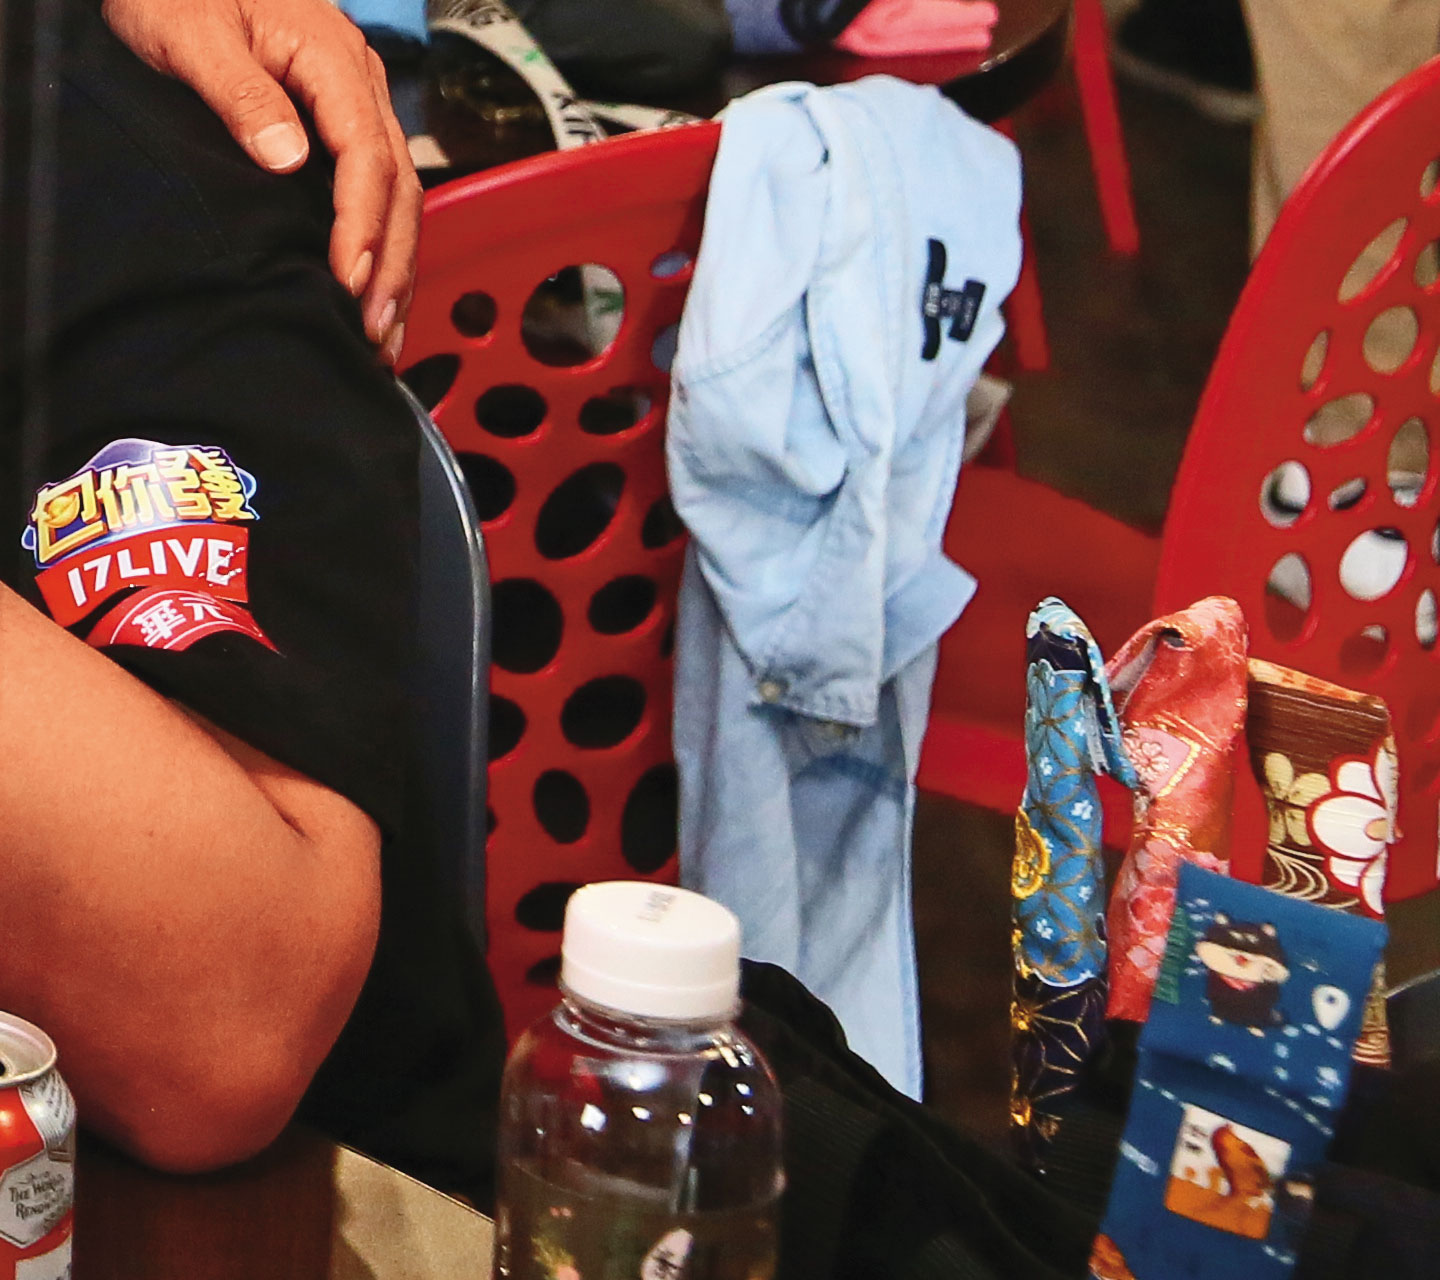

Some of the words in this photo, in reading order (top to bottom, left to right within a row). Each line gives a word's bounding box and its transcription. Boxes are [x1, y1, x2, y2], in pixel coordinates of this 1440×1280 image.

[32, 449, 254, 563] 包你發
[67, 538, 235, 607] 17LIVE
